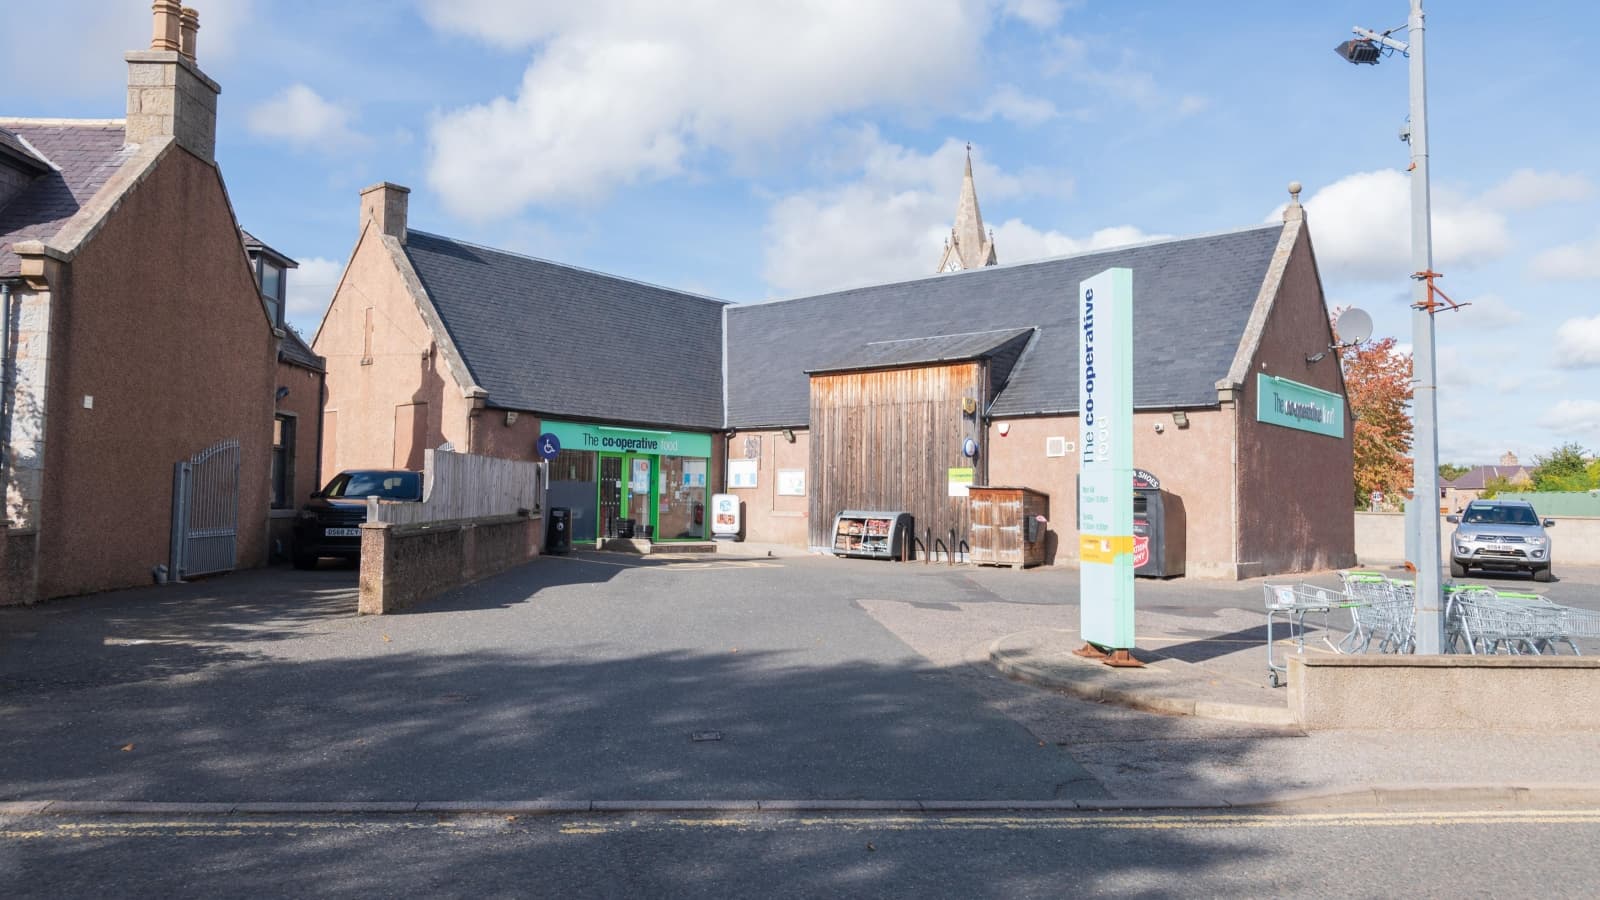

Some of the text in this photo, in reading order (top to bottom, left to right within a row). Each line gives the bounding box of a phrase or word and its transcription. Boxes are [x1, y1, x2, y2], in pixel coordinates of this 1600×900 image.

[1083, 288, 1096, 468] The co-operative
[1274, 392, 1284, 414] The
[583, 432, 599, 446] The
[661, 439, 678, 451] food
[1137, 471, 1159, 488] SHOES
